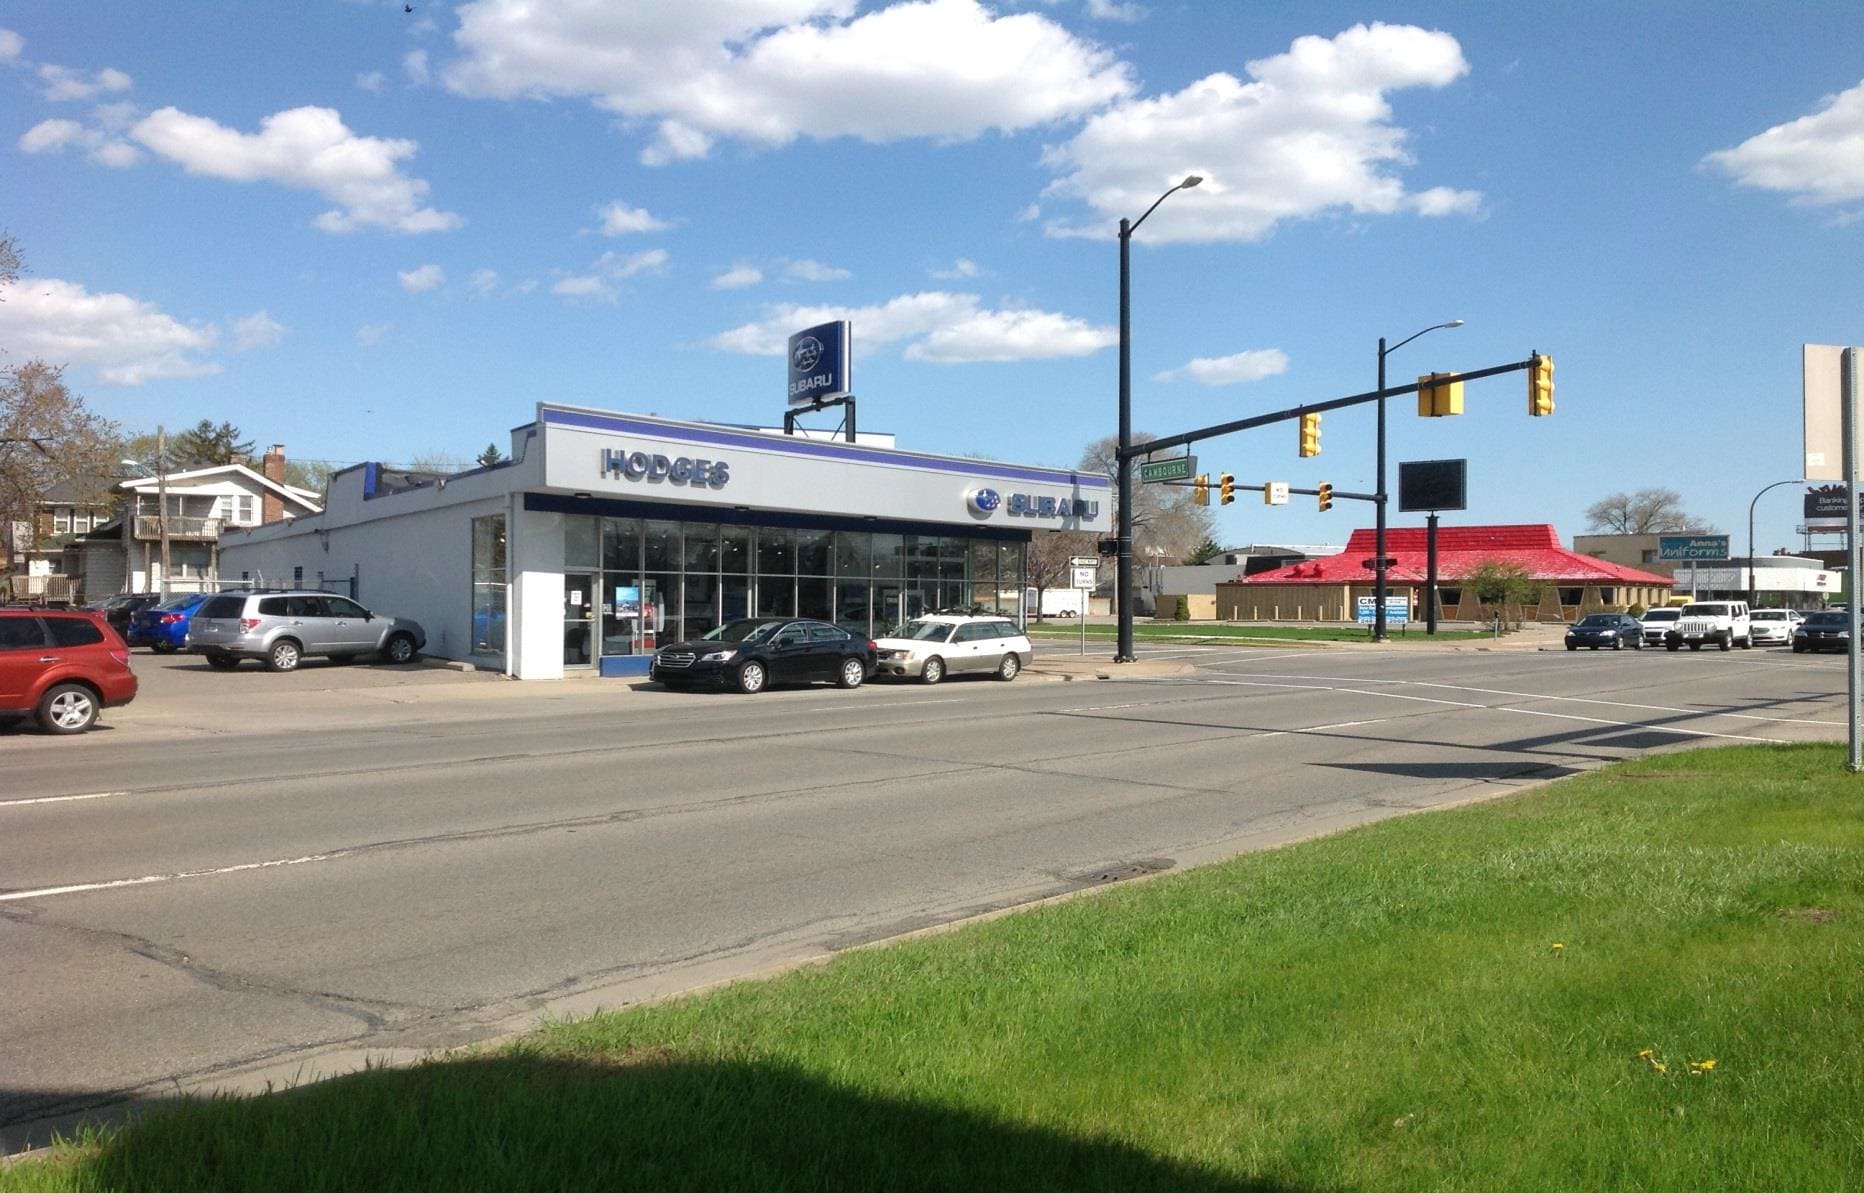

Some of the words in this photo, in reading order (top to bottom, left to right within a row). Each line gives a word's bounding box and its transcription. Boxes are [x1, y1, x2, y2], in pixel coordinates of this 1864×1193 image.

[789, 373, 832, 395] SUBARU
[603, 449, 730, 487] HODGES
[1143, 463, 1187, 478] CAMBOURNE
[1010, 493, 1099, 519] SUBARU
